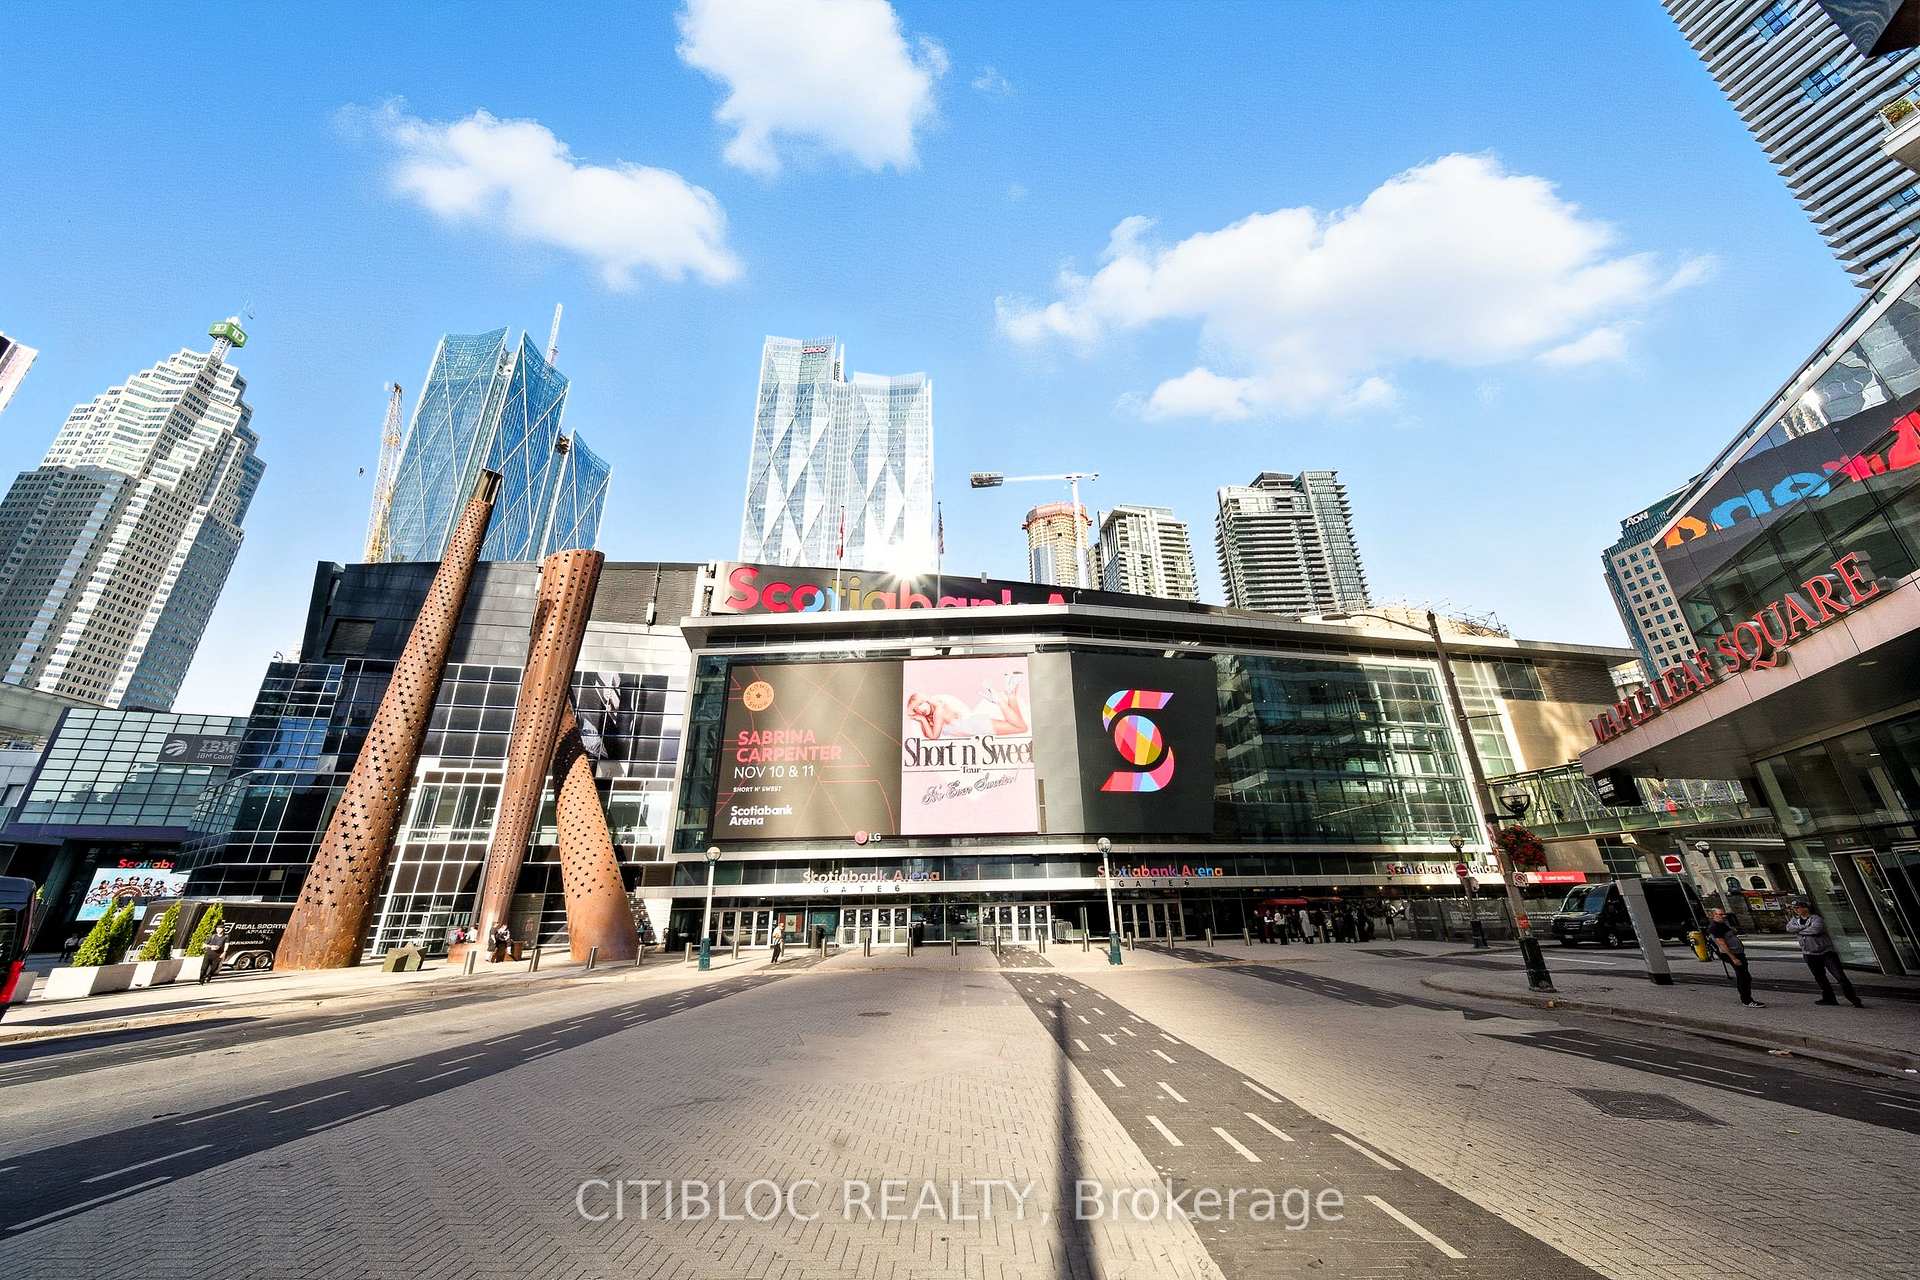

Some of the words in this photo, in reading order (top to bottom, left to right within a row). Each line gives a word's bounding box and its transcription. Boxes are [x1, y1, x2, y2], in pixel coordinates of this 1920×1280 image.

[1625, 511, 1649, 529] AON
[1650, 647, 1714, 711] LEAF
[1716, 551, 1880, 673] SQUARE
[738, 730, 816, 746] SABRINA
[736, 745, 842, 763] CARPENTER
[904, 737, 957, 767] Short
[982, 735, 1034, 766] Sweet
[734, 765, 766, 779] NOV
[769, 765, 785, 778] 10
[788, 765, 799, 778] &
[802, 764, 815, 777] 11
[961, 766, 981, 774] Tour
[730, 804, 793, 816] Scotiabank
[729, 816, 764, 826] Arena
[868, 832, 882, 842] LG
[117, 858, 176, 869] Scotiab
[802, 868, 887, 883] Scotiabank
[892, 869, 940, 882] Arena
[1097, 864, 1177, 878] Sotiabank
[1182, 864, 1223, 877] Arena
[823, 885, 882, 893] GATE
[1118, 879, 1174, 888] GATE
